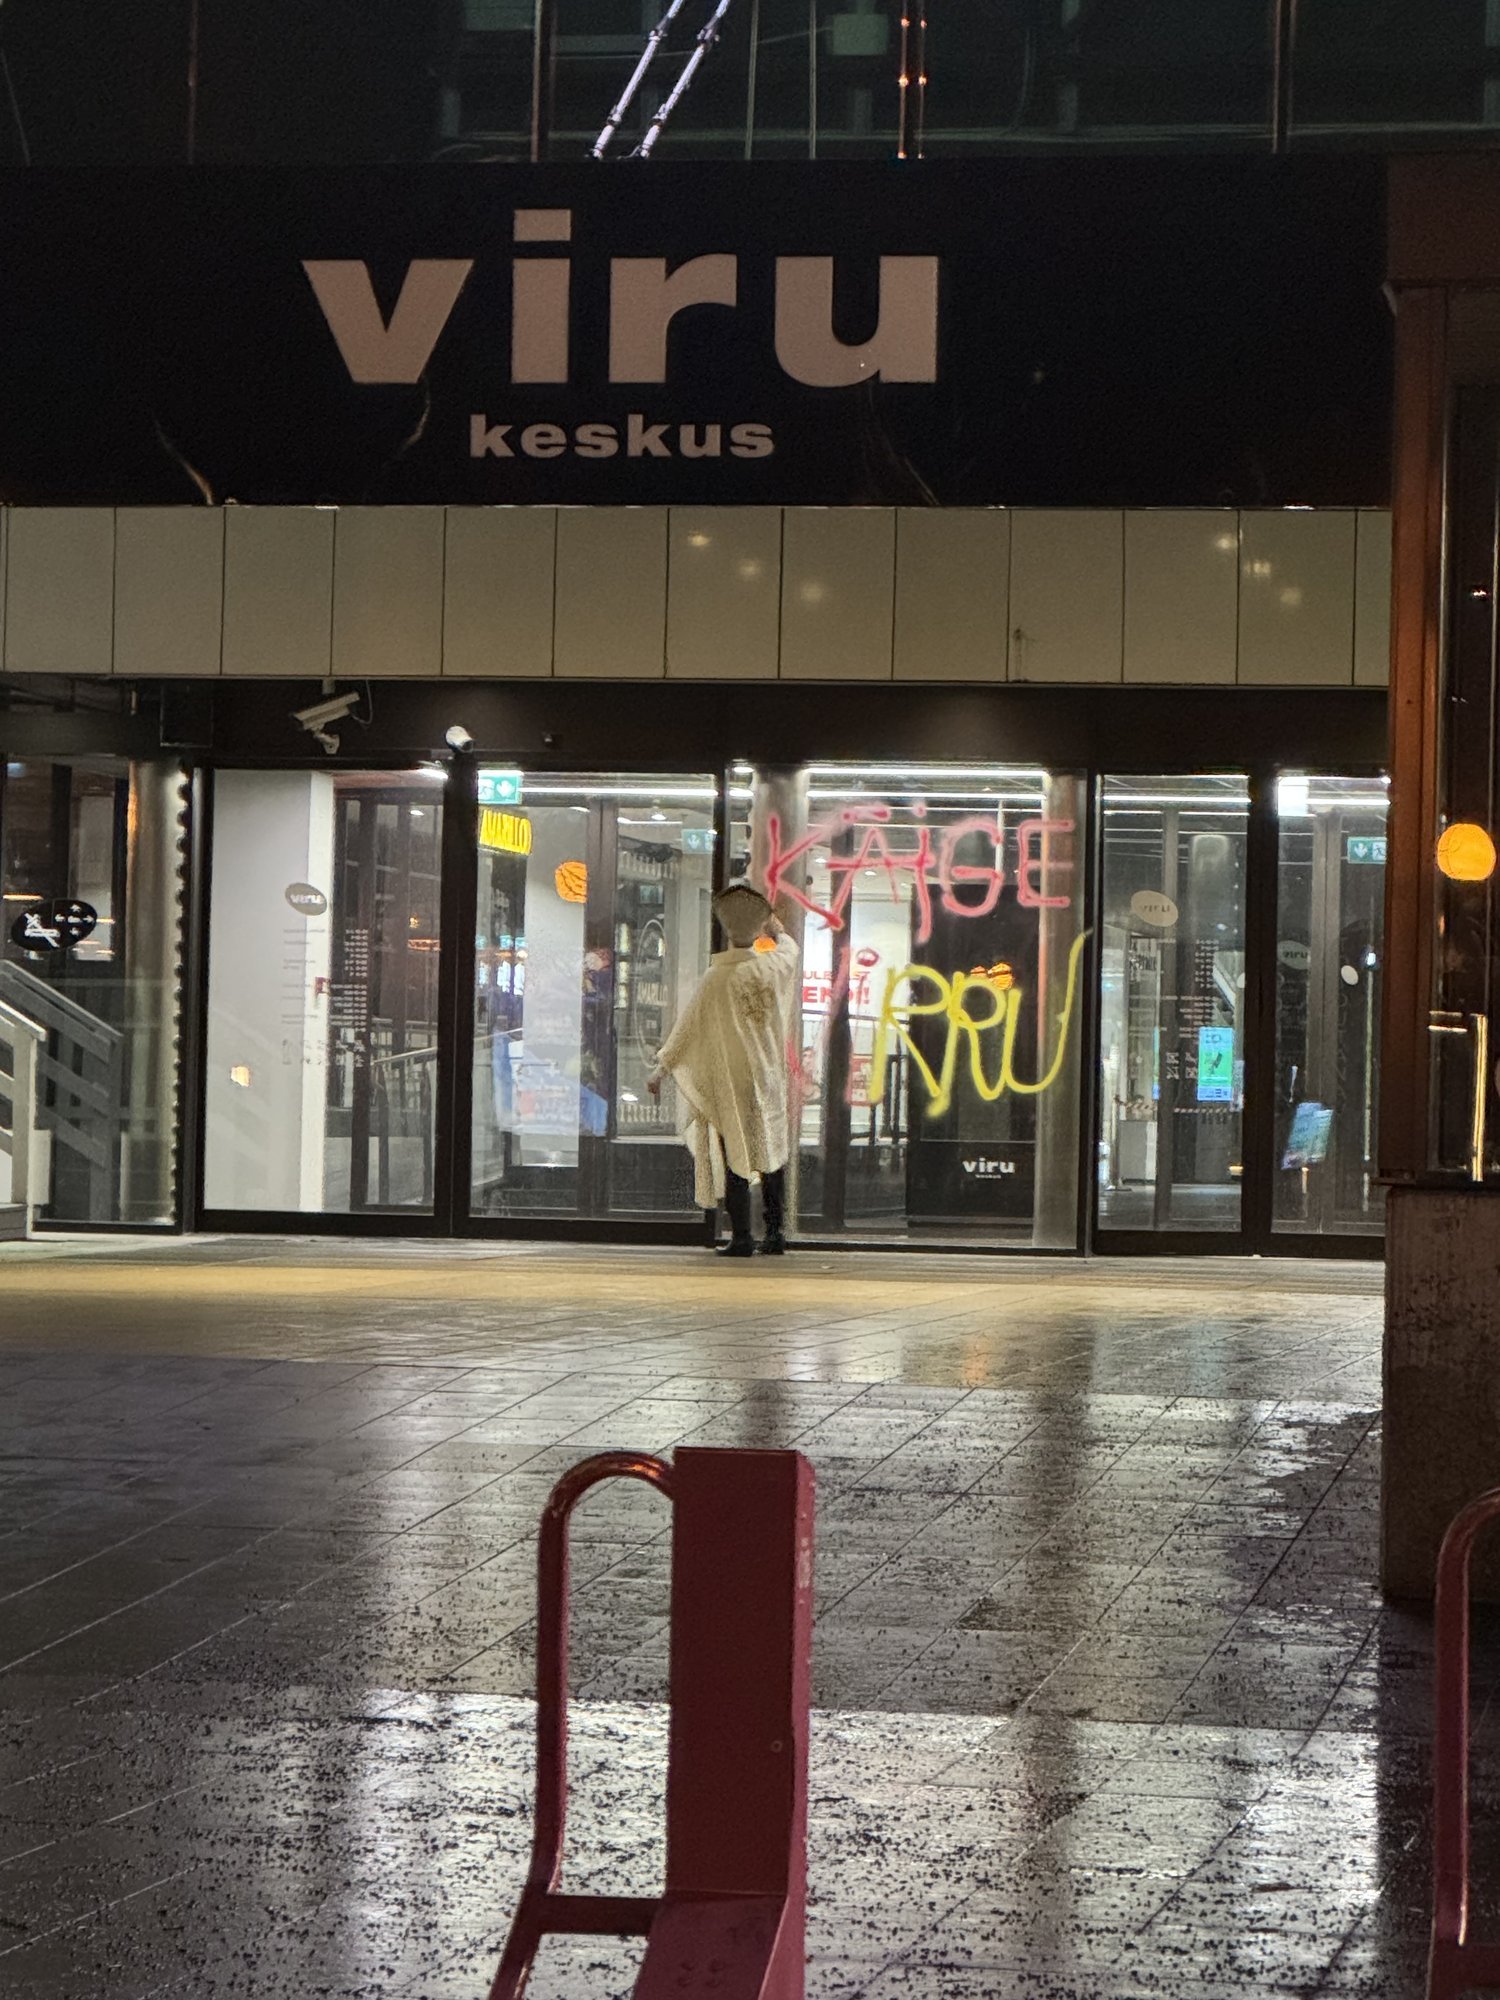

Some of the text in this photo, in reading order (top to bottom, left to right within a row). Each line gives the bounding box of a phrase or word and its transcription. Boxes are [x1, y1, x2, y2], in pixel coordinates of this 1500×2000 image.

[302, 208, 940, 387] viru
[469, 413, 775, 459] keskus
[962, 1157, 1016, 1173] viru
